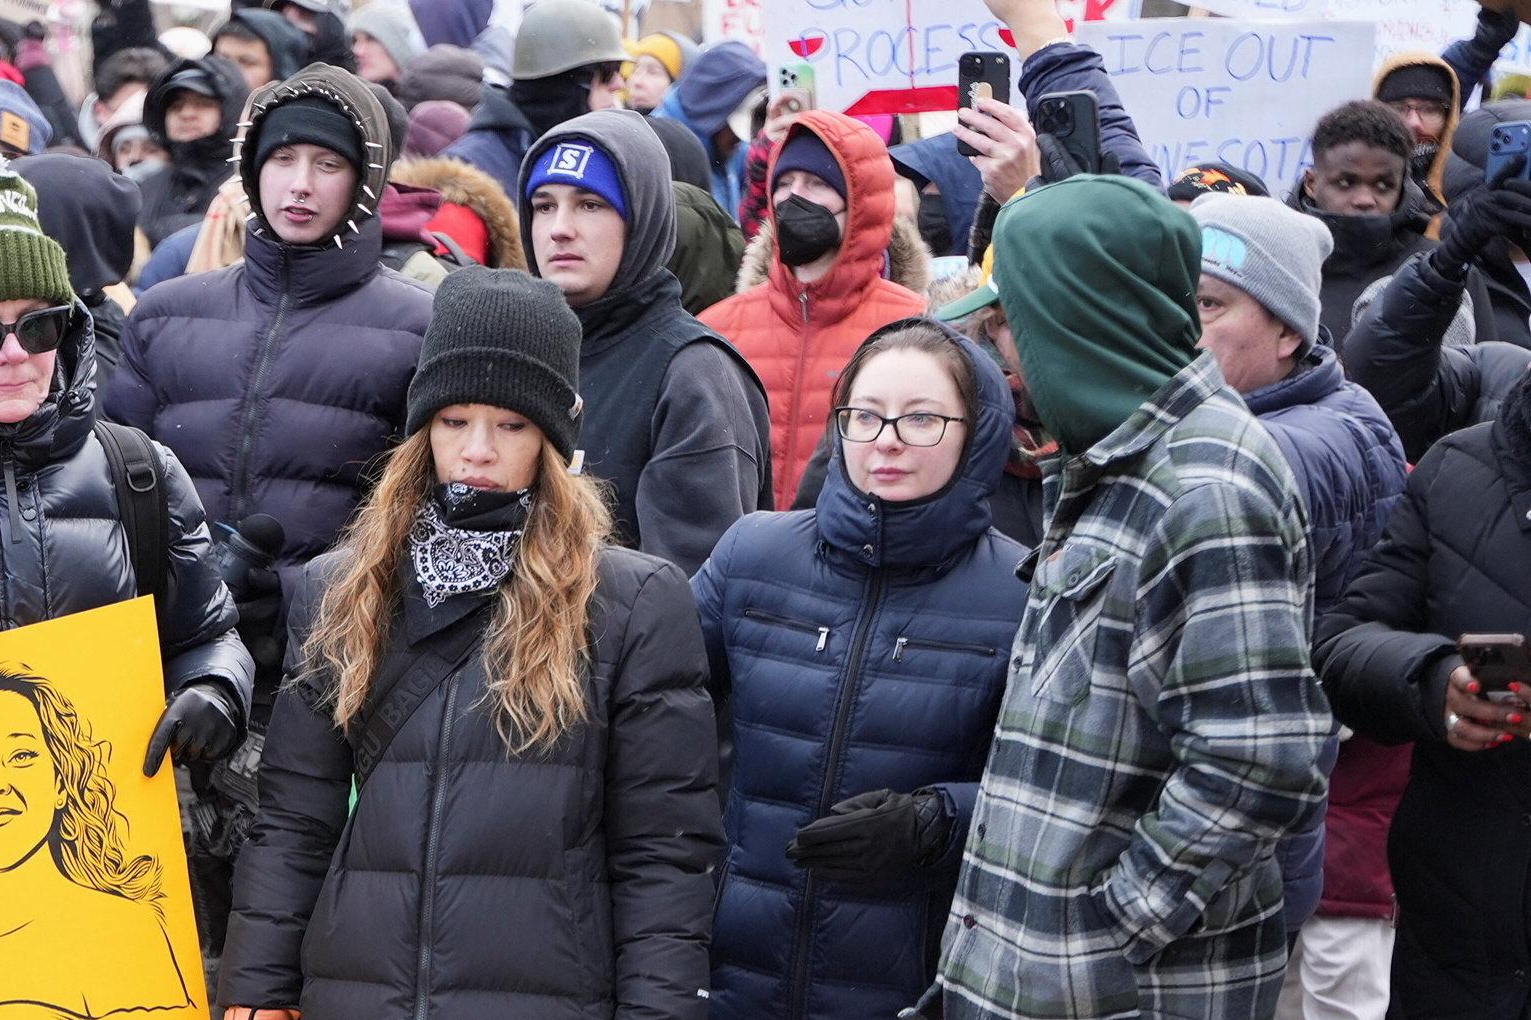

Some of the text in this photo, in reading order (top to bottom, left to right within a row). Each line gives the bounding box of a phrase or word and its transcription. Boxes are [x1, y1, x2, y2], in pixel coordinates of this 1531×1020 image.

[799, 21, 1000, 87] PROCESS
[1107, 31, 1204, 76] ICE
[1225, 31, 1335, 82] OUT
[1176, 85, 1232, 119] OF
